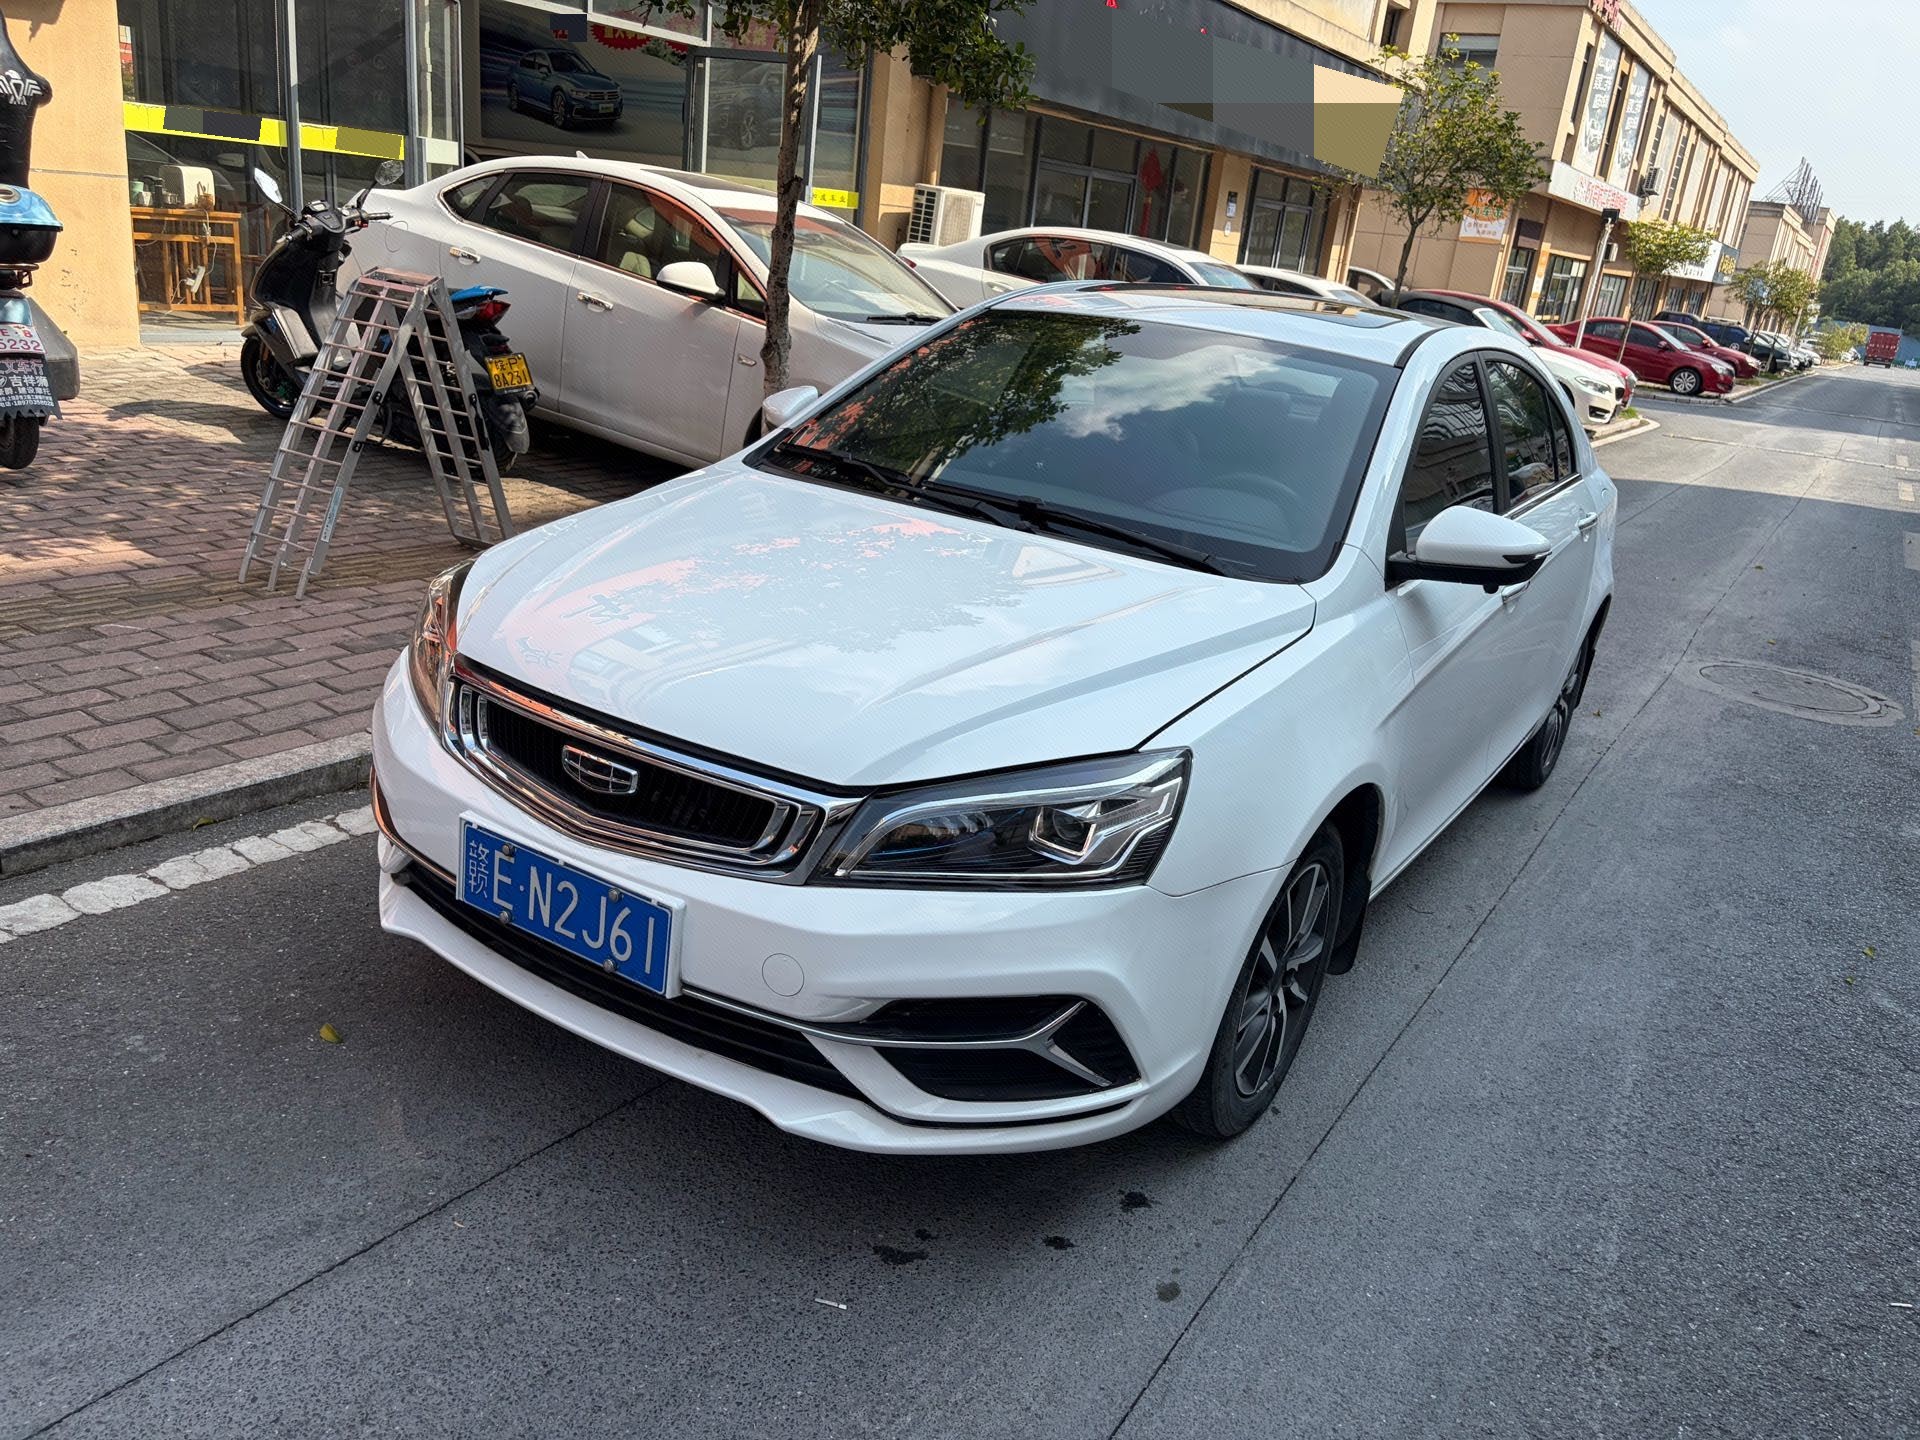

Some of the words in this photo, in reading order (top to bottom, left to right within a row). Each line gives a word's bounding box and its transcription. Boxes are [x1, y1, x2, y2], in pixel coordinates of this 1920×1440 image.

[0, 358, 44, 375] 文车行
[493, 369, 528, 388] 8A231
[468, 839, 655, 974] 赣E·N2J61
